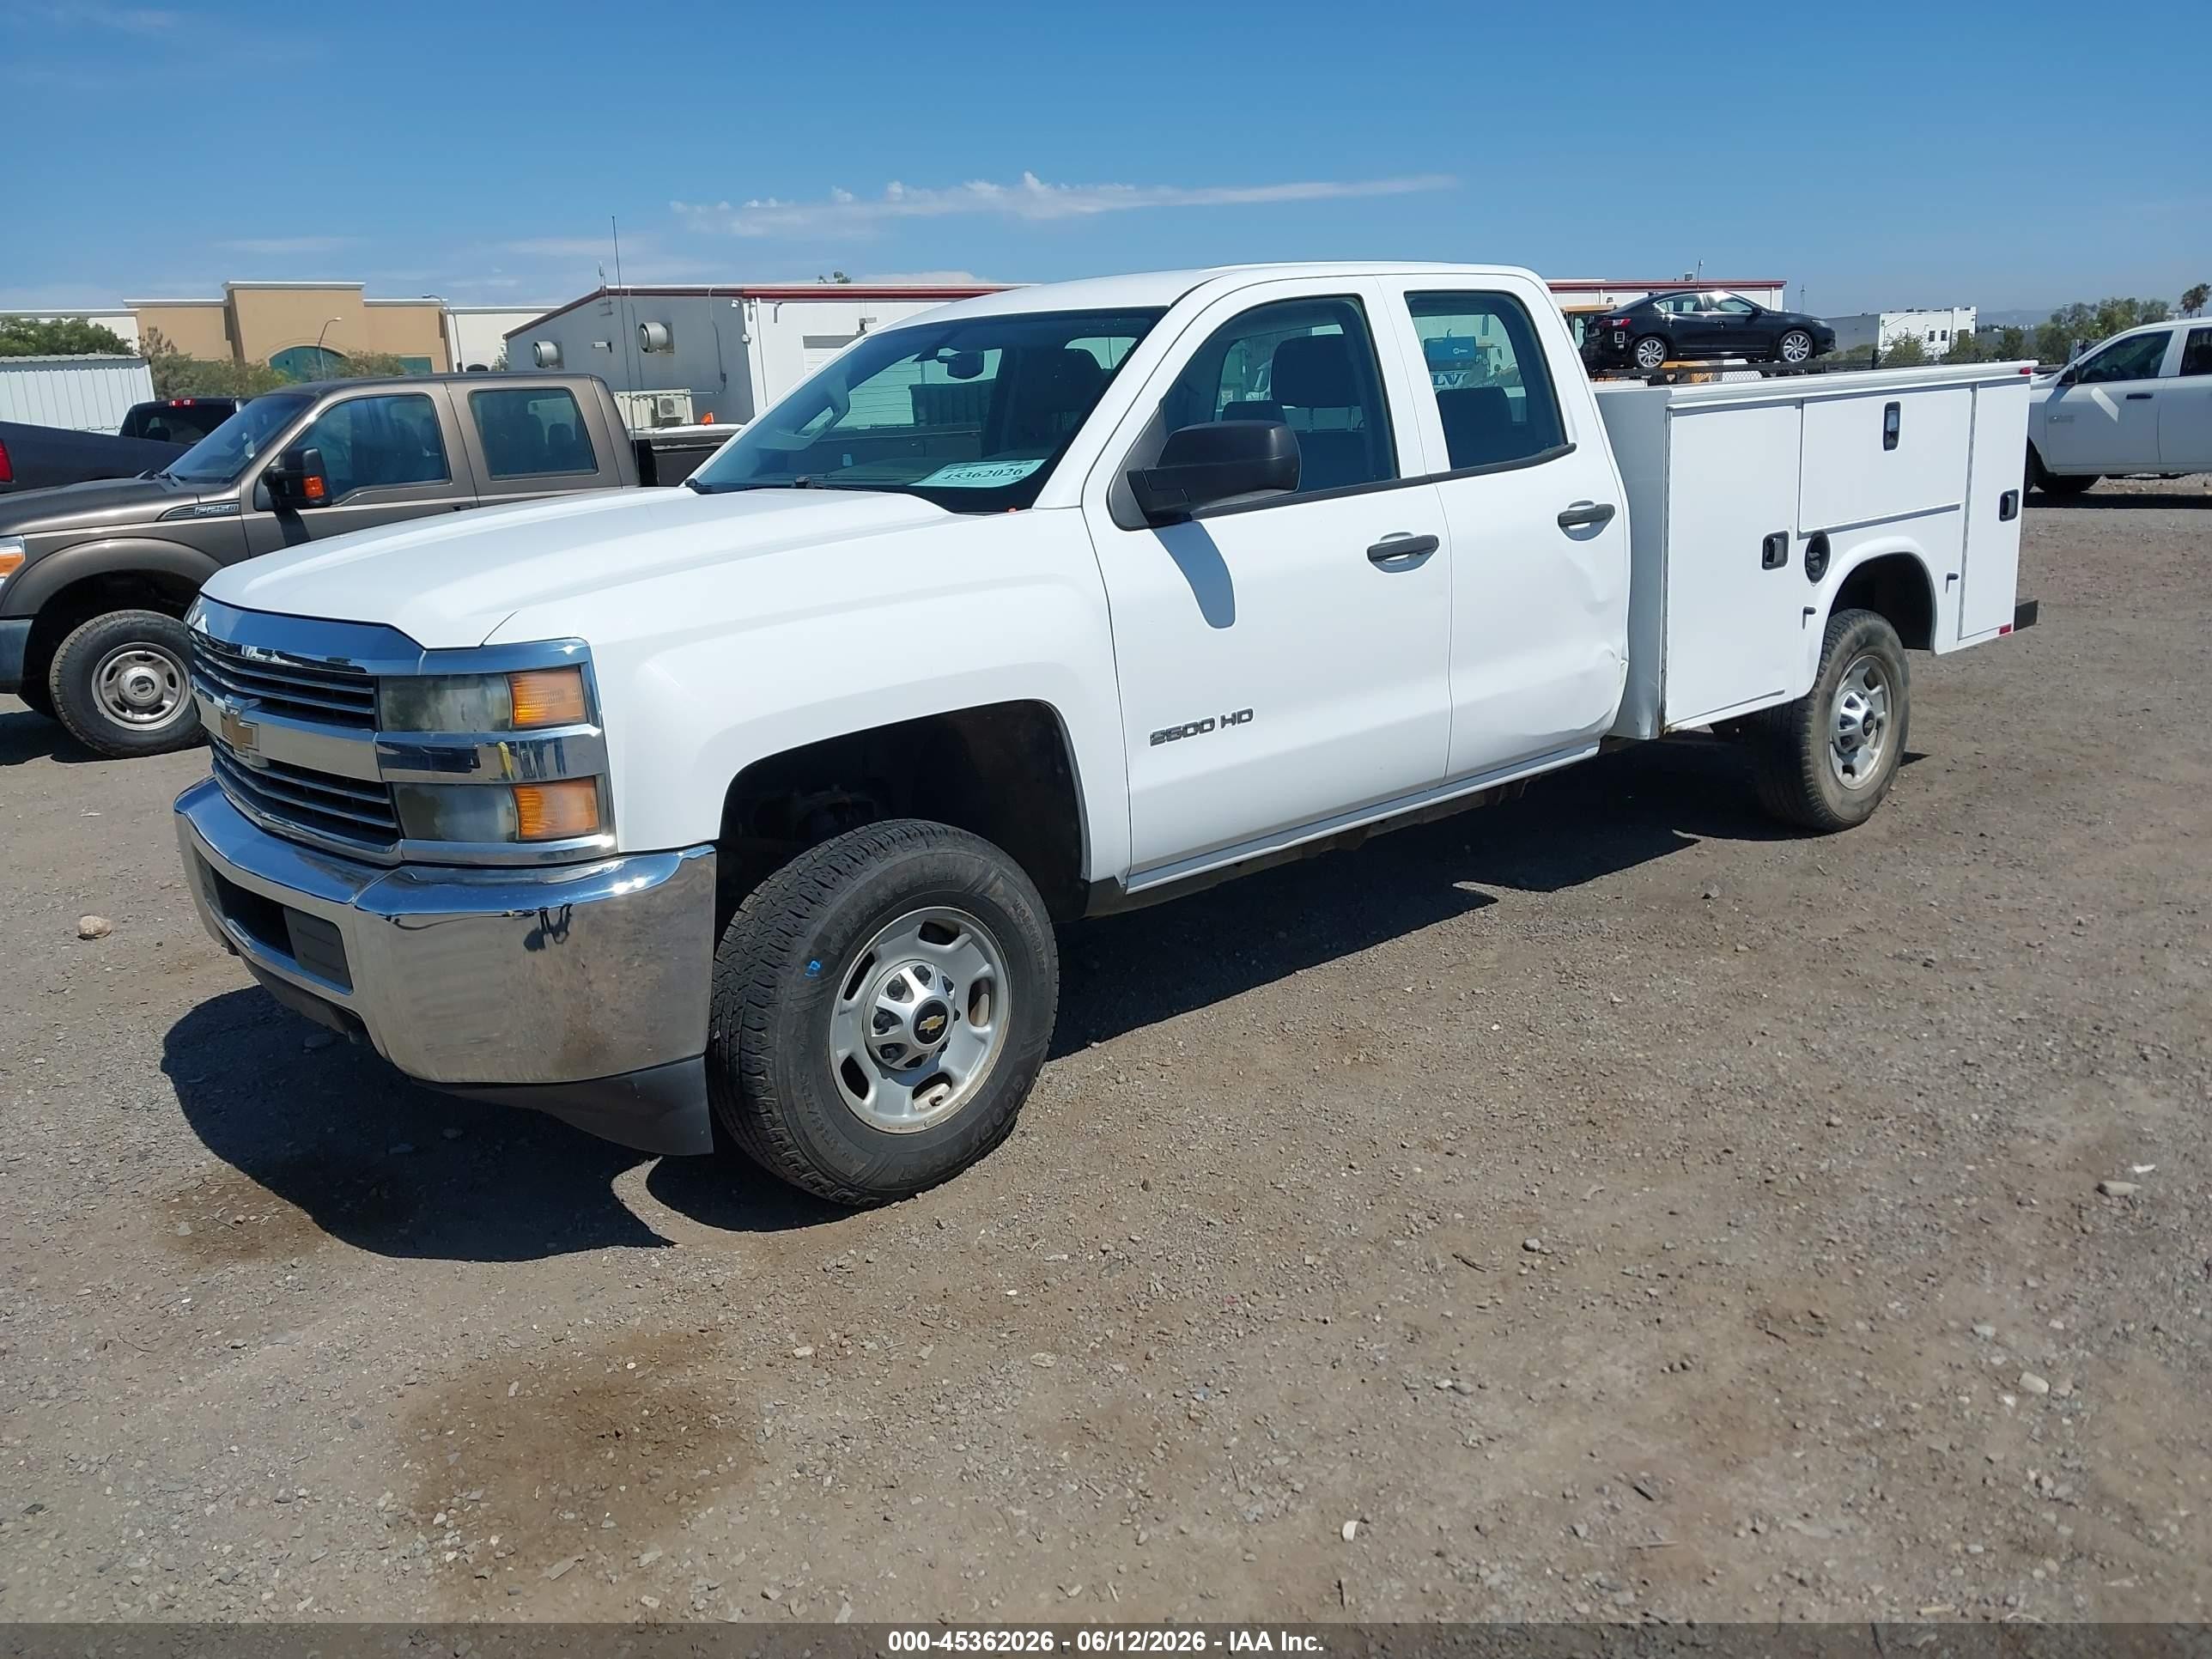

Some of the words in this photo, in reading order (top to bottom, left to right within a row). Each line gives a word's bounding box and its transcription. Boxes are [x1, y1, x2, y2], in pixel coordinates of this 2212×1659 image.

[941, 466, 1024, 480] 45362026
[1150, 715, 1216, 746] 2500
[1219, 708, 1254, 728] HD
